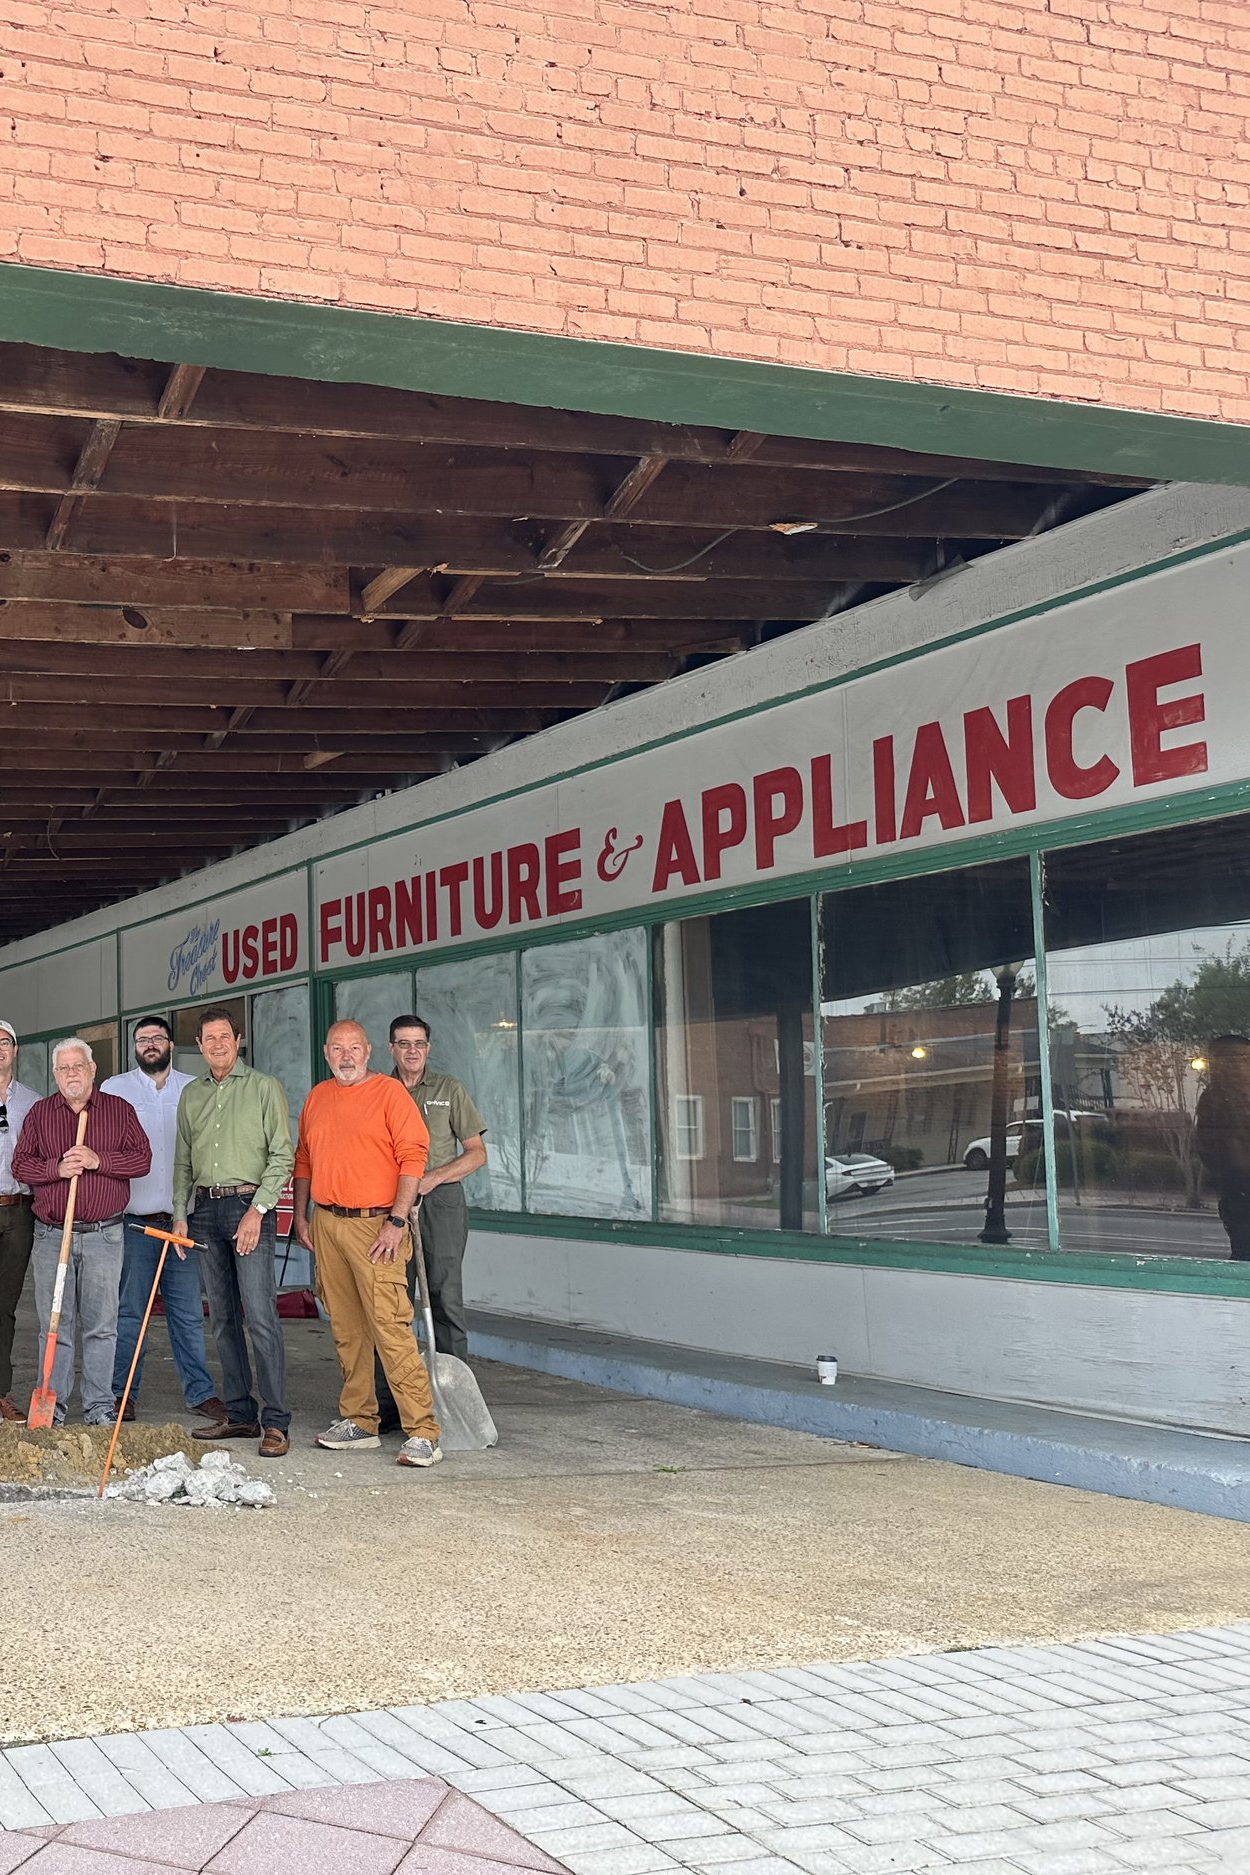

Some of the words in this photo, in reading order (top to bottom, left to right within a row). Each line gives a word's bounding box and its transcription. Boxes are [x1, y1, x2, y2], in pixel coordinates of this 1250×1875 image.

[222, 913, 298, 984] USED
[320, 828, 582, 963] FURNITURE
[597, 827, 643, 882] &
[652, 643, 1208, 892] APPLIANCE
